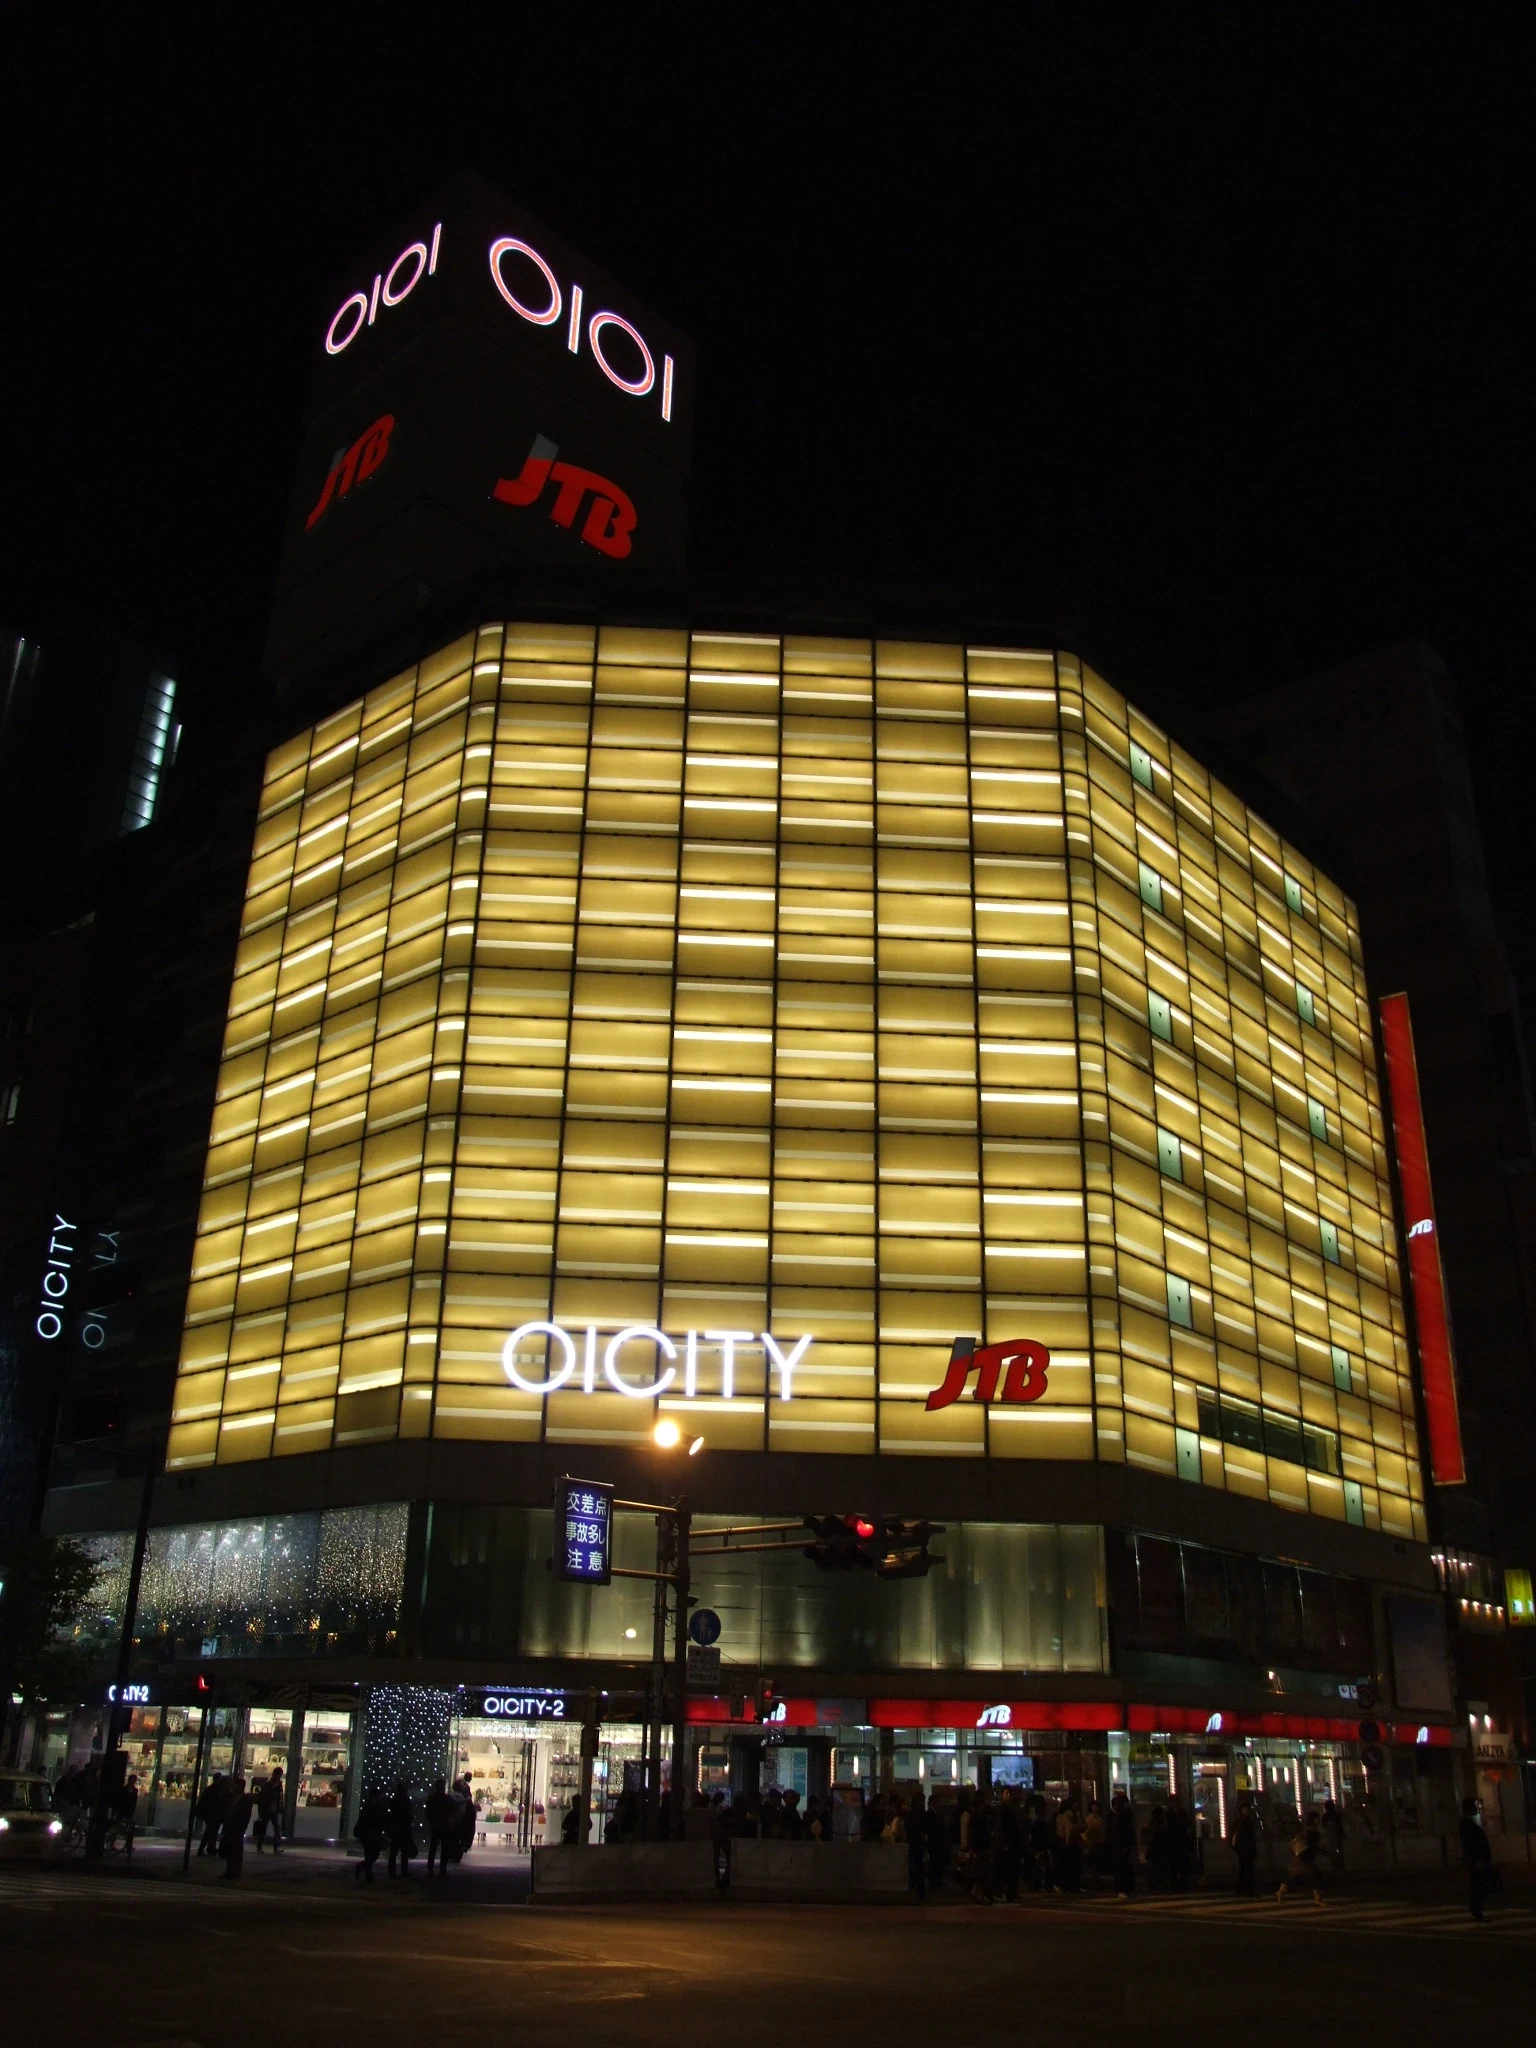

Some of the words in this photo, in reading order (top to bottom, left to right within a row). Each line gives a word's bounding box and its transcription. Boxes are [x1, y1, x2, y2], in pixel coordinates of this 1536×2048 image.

[305, 413, 395, 532] JTB
[492, 433, 639, 560] JTB
[1408, 1219, 1433, 1238] JTB
[37, 1213, 78, 1339] OICITY
[502, 1321, 813, 1401] OICITY
[925, 1337, 1051, 1411] JTB
[566, 1491, 607, 1516] 交差点
[565, 1520, 605, 1545] 事故多し
[567, 1548, 604, 1571] 注意
[484, 1696, 564, 1716] OICITY-2
[976, 1704, 1011, 1727] JTB
